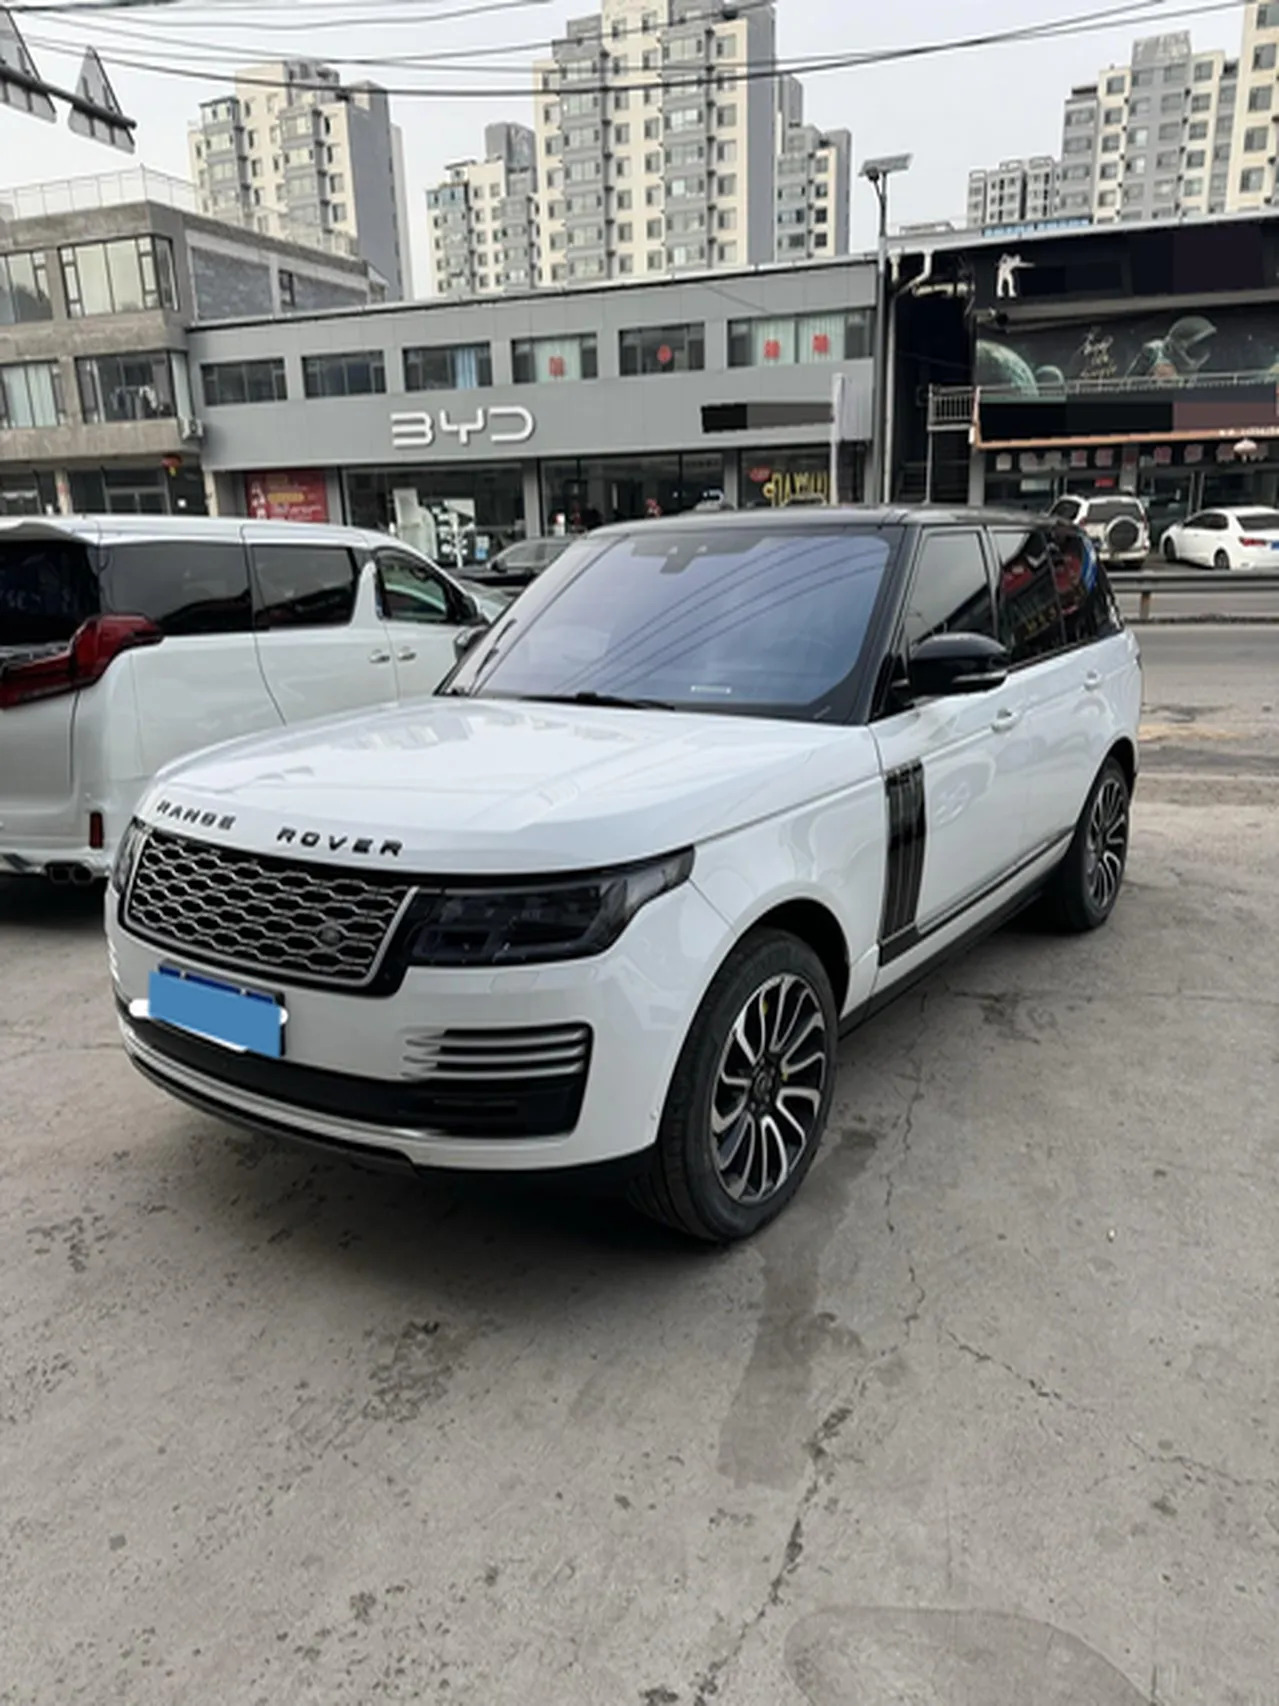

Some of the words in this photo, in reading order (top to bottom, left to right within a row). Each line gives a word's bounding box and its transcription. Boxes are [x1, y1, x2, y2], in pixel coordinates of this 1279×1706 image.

[390, 405, 535, 446] BYD
[156, 799, 237, 831] RANGE
[276, 826, 404, 857] ROVER
